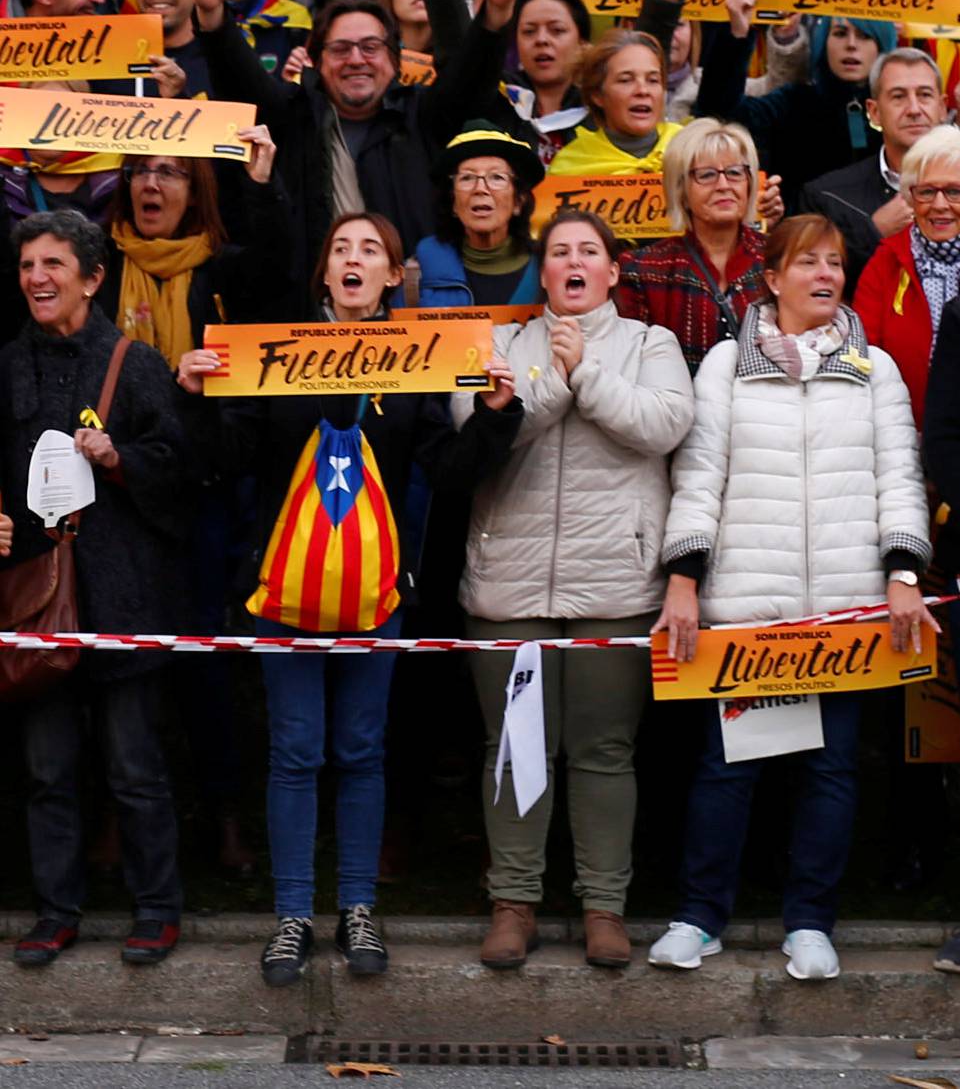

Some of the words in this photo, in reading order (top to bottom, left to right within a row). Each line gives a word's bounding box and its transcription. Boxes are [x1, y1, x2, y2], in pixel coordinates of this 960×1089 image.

[82, 98, 103, 106] SOM
[105, 100, 154, 109] REPÚBLICA
[29, 102, 202, 145] Llibertat!
[75, 141, 109, 150] PRESOS
[583, 179, 624, 187] REPUBLIC
[626, 178, 638, 186] OF
[417, 313, 439, 321] SOM
[441, 311, 491, 320] REPÚBLICA
[290, 329, 335, 337] REPUBLIC
[338, 328, 351, 336] OF
[353, 327, 408, 336] CATALONIA
[258, 333, 441, 390] Freedom!
[299, 381, 346, 390] POLITICAL
[349, 380, 400, 389] PRISONERS
[755, 633, 778, 641] SOM
[780, 630, 832, 640] REPÚBLICA
[708, 632, 882, 693] Llibertat!
[757, 683, 793, 692] PRESOS
[795, 680, 835, 690] POLÍTICS
